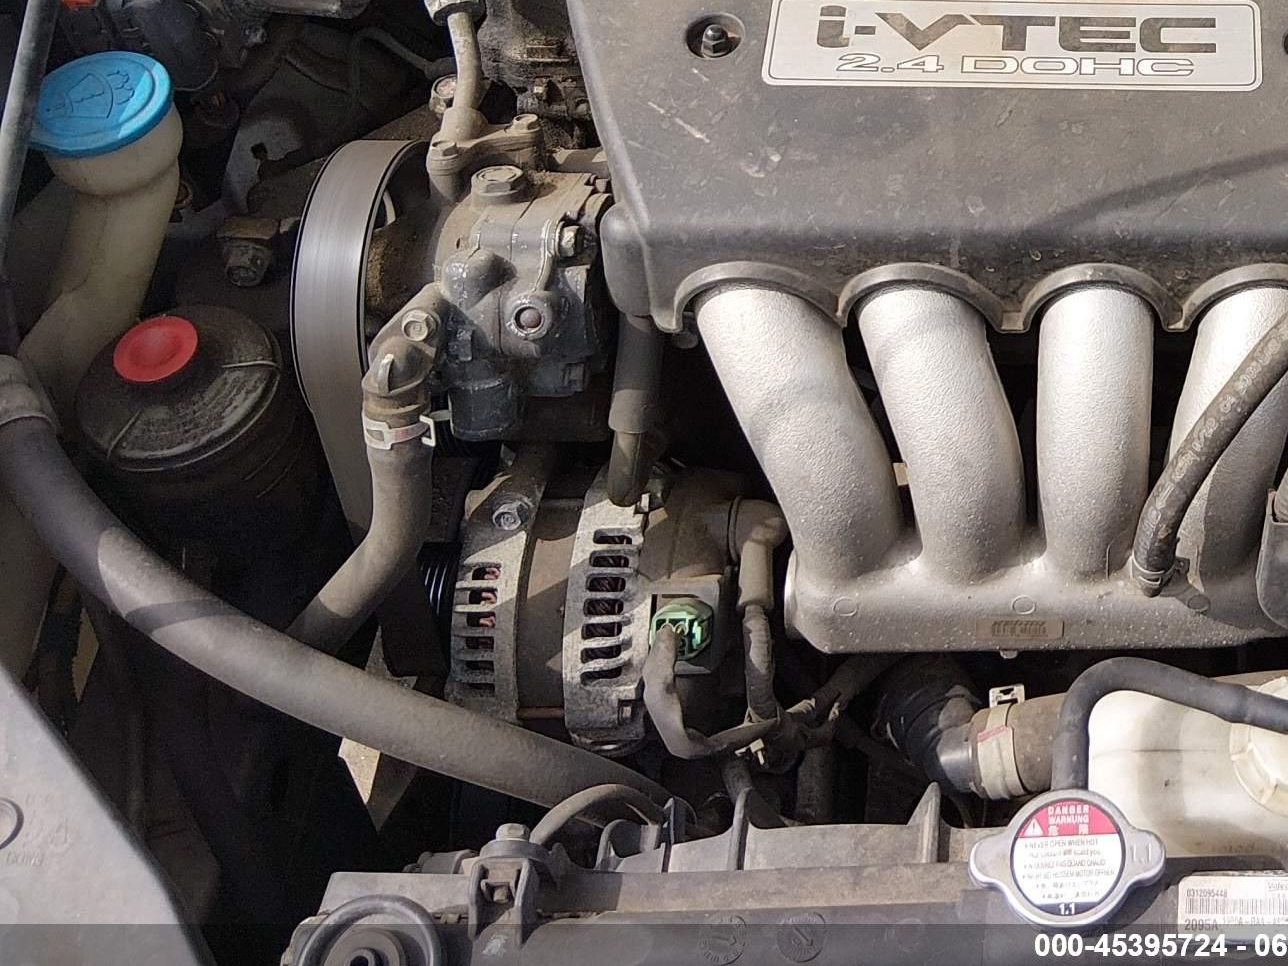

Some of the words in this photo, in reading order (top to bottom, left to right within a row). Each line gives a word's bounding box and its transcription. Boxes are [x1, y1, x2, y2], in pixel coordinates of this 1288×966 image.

[817, 5, 1217, 53] i-VTEC
[836, 53, 945, 74] 2.4
[961, 56, 1195, 77] DOHC
[1047, 805, 1089, 815] DANGER
[1048, 814, 1089, 824] WARNUNG
[1058, 902, 1076, 915] 1.1
[1184, 918, 1219, 931] 2095A
